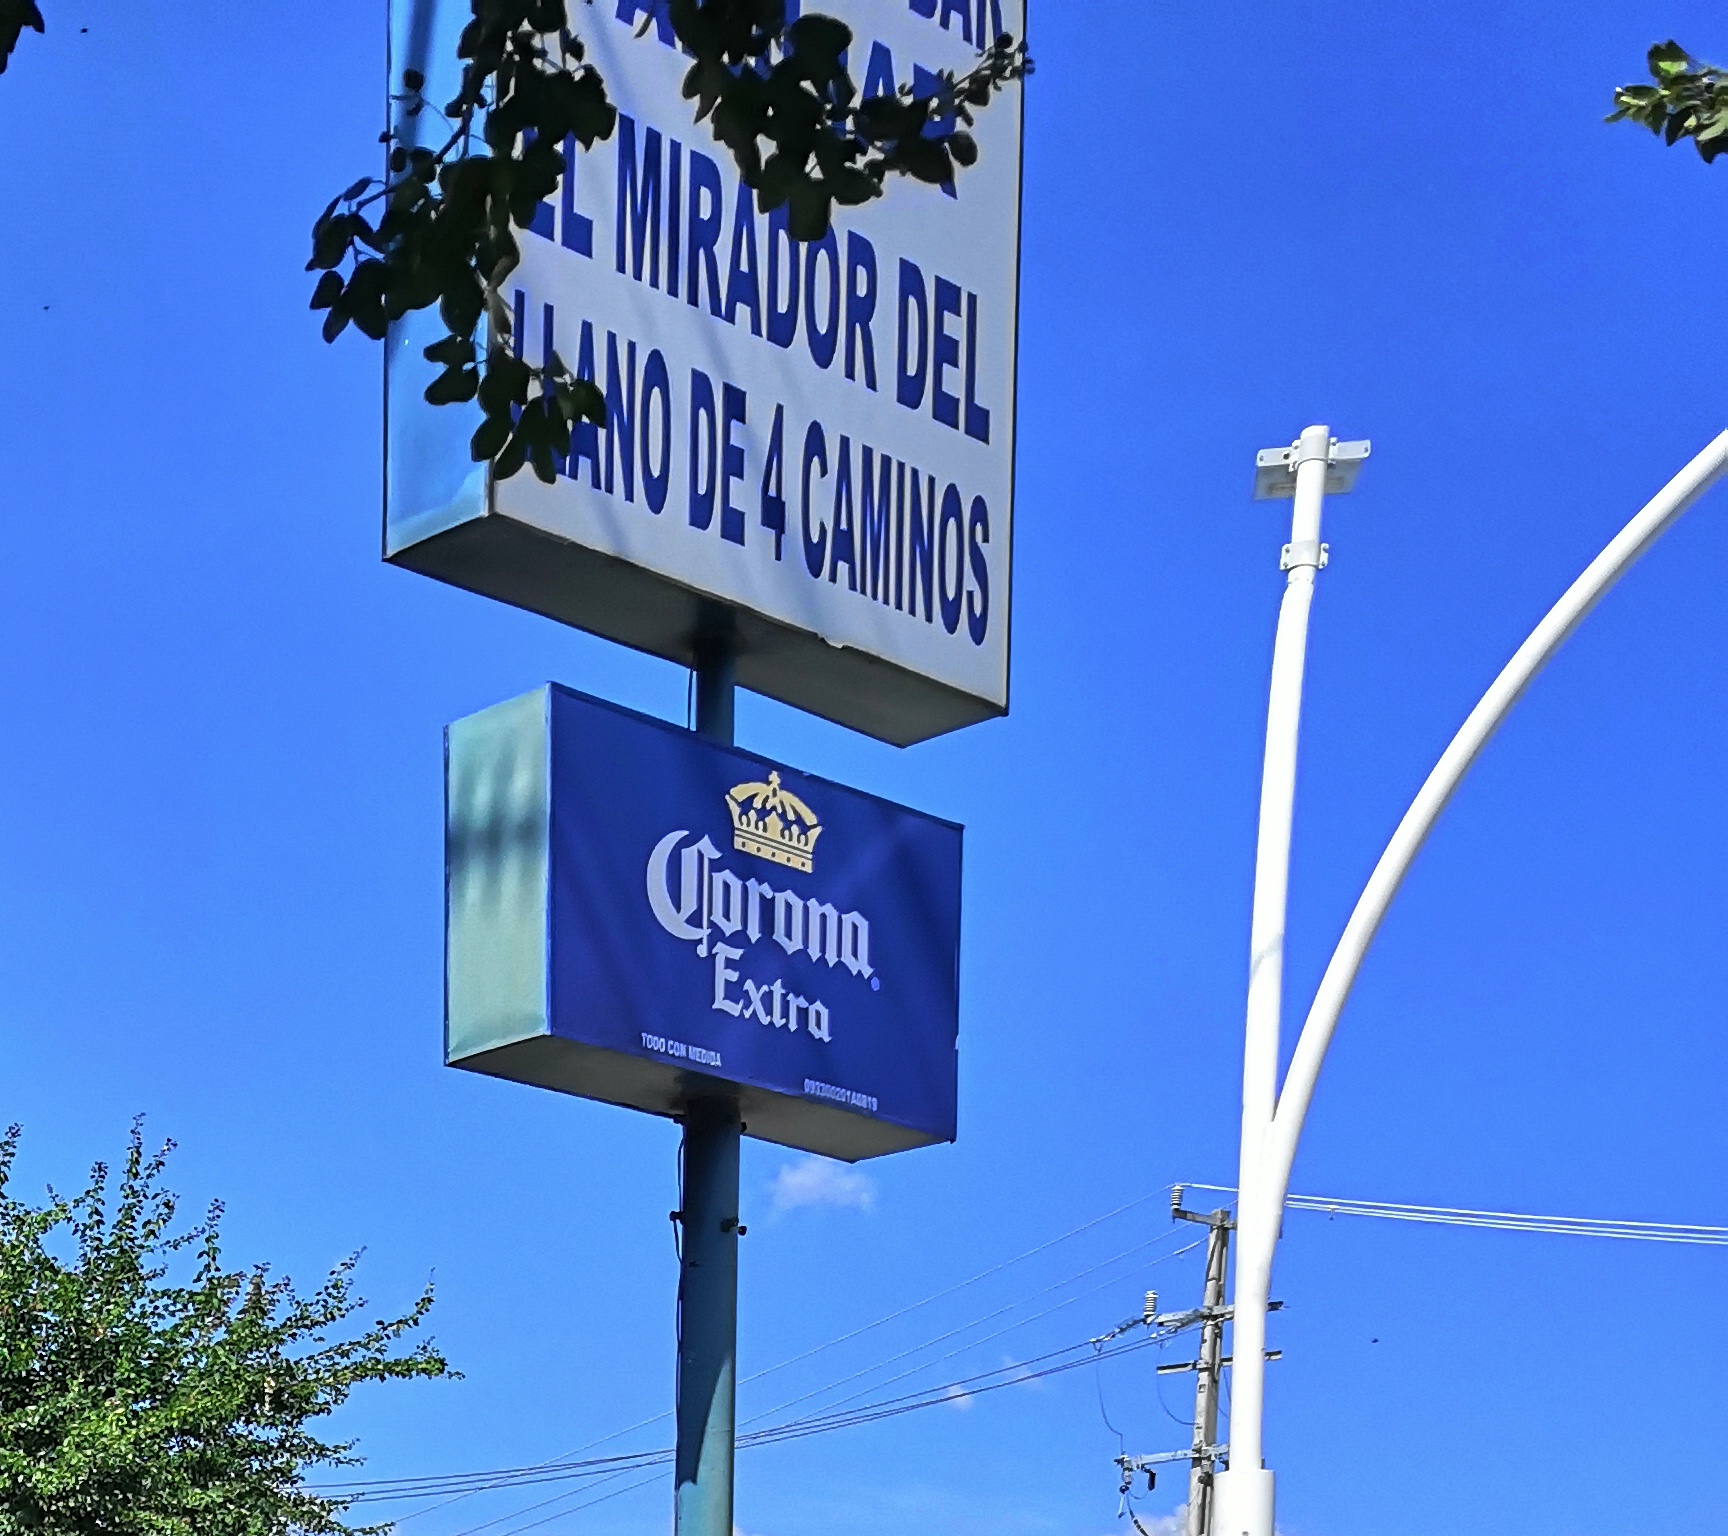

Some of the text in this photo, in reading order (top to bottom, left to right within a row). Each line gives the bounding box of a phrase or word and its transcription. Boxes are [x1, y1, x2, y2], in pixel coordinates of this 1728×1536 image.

[897, 257, 991, 445] DEL
[688, 368, 746, 547] DE
[761, 403, 786, 562] 4
[802, 420, 991, 646] CAMINOS
[646, 829, 874, 980] Corona
[712, 942, 833, 1043] Extra
